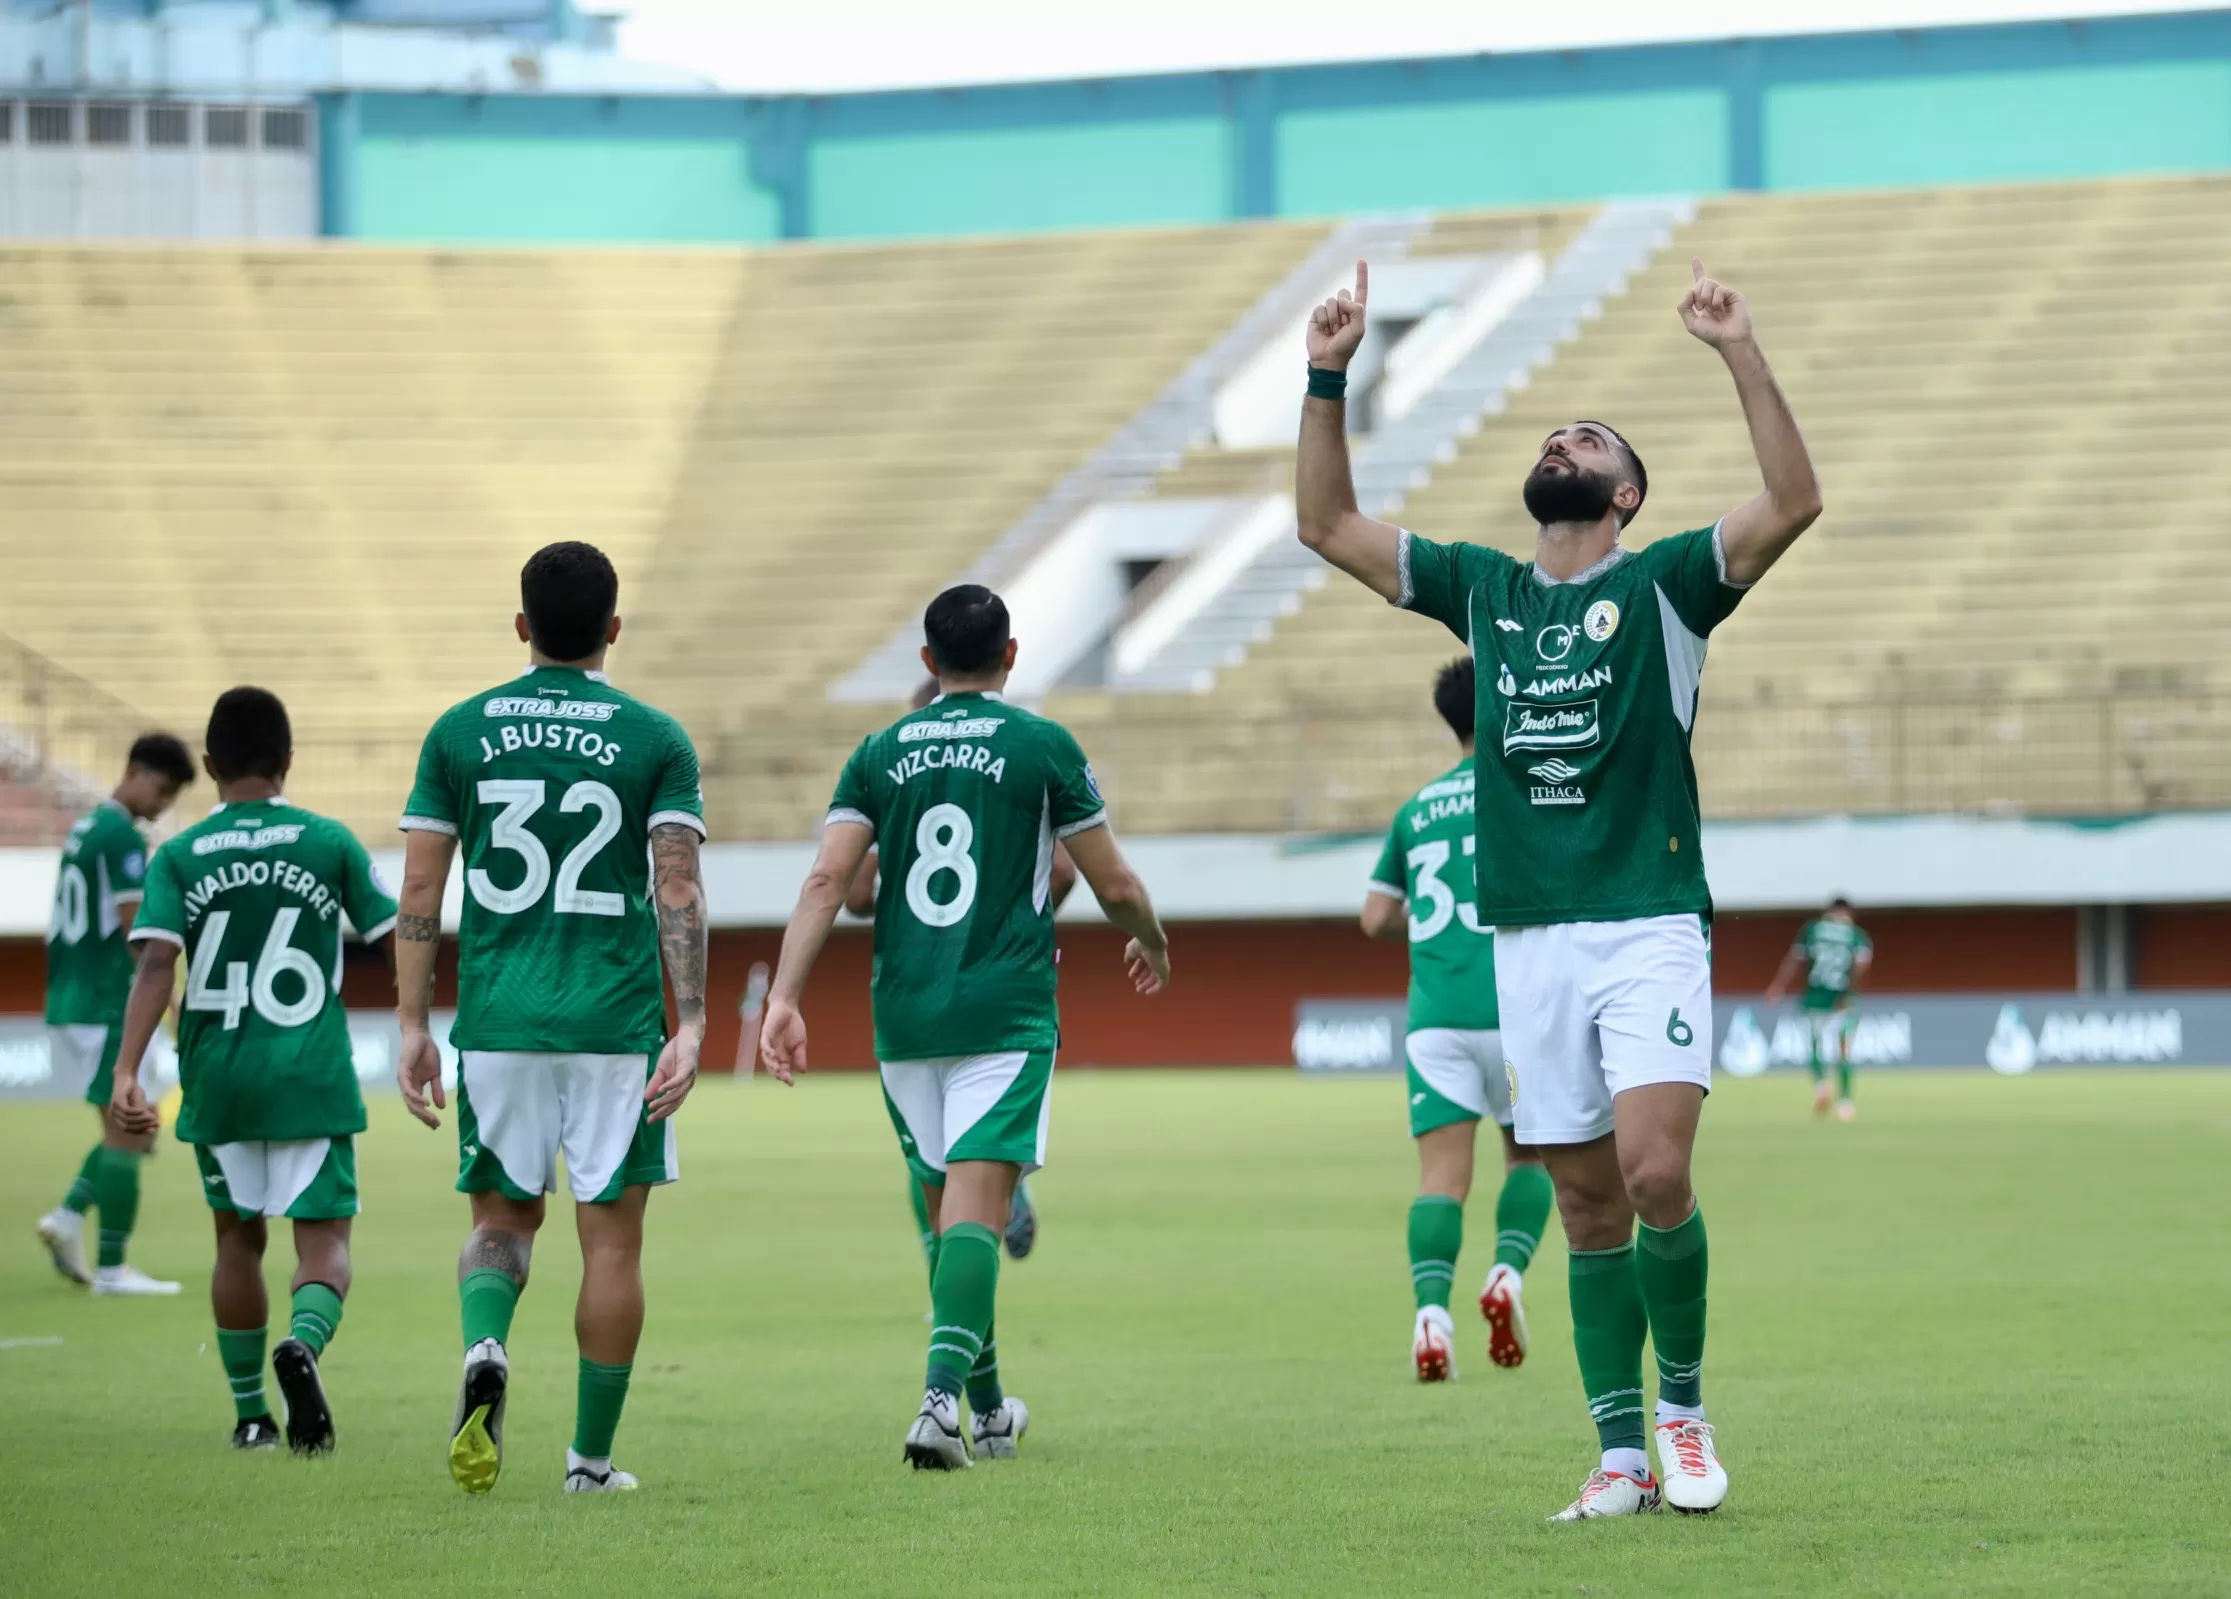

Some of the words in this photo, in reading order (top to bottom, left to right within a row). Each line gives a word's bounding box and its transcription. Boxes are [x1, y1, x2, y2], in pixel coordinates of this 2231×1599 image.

[1522, 665, 1612, 696] AMMAN
[887, 744, 1006, 785] VIZCARRA
[1530, 787, 1584, 798] ITHACA
[467, 779, 625, 916] 32
[905, 802, 977, 927] 8
[185, 907, 326, 1031] 46
[1666, 1007, 1693, 1047] 6
[2037, 1008, 2183, 1063] AMMAN
